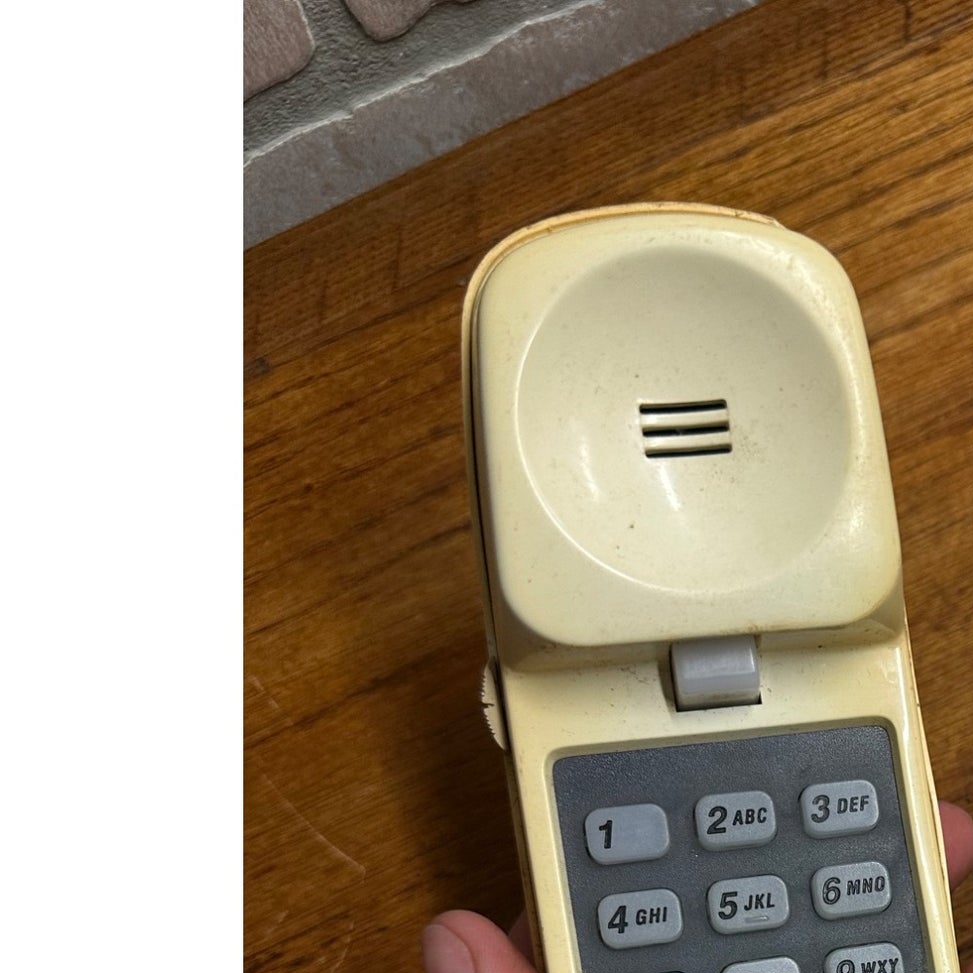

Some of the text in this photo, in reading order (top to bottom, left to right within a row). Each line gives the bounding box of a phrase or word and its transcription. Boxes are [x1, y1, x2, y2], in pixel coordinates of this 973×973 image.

[706, 806, 768, 835] 2 ABC
[811, 794, 870, 823] 3 DEF
[598, 820, 614, 849] 1
[822, 875, 885, 905] 6 MNO
[607, 905, 668, 934] 4 GHI
[718, 891, 776, 920] 5 JKL
